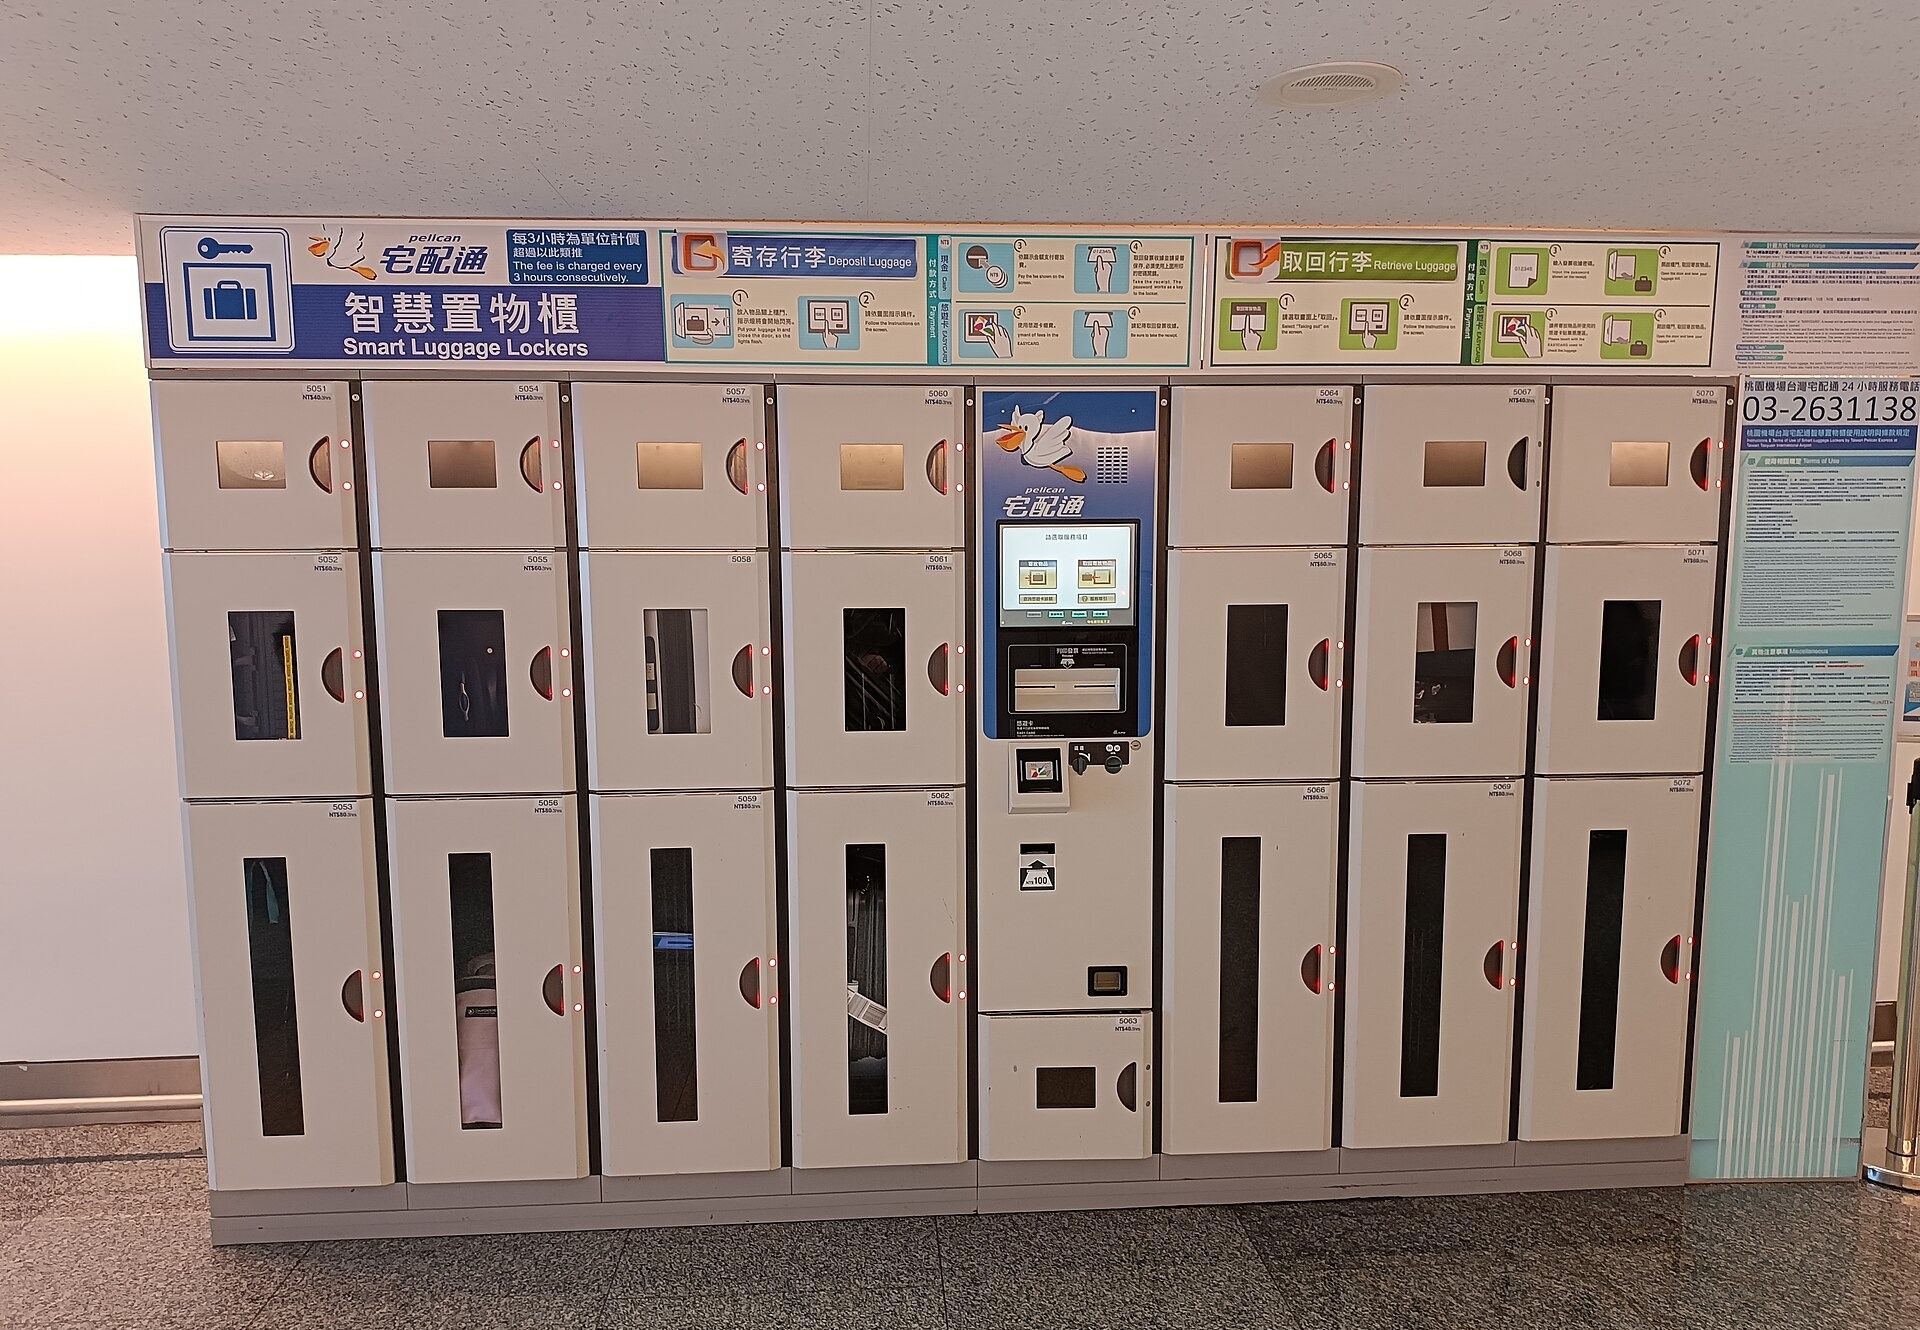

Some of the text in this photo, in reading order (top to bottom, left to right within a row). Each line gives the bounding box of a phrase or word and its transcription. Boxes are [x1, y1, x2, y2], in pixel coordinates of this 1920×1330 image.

[408, 233, 461, 243] pelican
[512, 232, 641, 246] 每3小時為單位計價
[380, 245, 488, 275] 宅配通
[512, 247, 583, 258] 超過以此類推
[731, 245, 912, 269] 寄存行李 Deposit Luggage
[1282, 250, 1456, 273] 取回行李 Retrieve Luggage
[513, 261, 642, 273] The fee is charged every
[513, 272, 630, 284] 3 hours consecutively.
[344, 291, 580, 335] 智慧置物櫃
[928, 305, 937, 338] Payment
[1464, 308, 1473, 339] Payment
[343, 338, 589, 360] Smart Luggage Lockers
[1744, 381, 1920, 392] 桃園機場台灣宅配通 24 小時服務電話
[1743, 396, 1917, 422] 03-2631138
[1025, 486, 1066, 494] pelican
[1002, 495, 1085, 518] 宅配通
